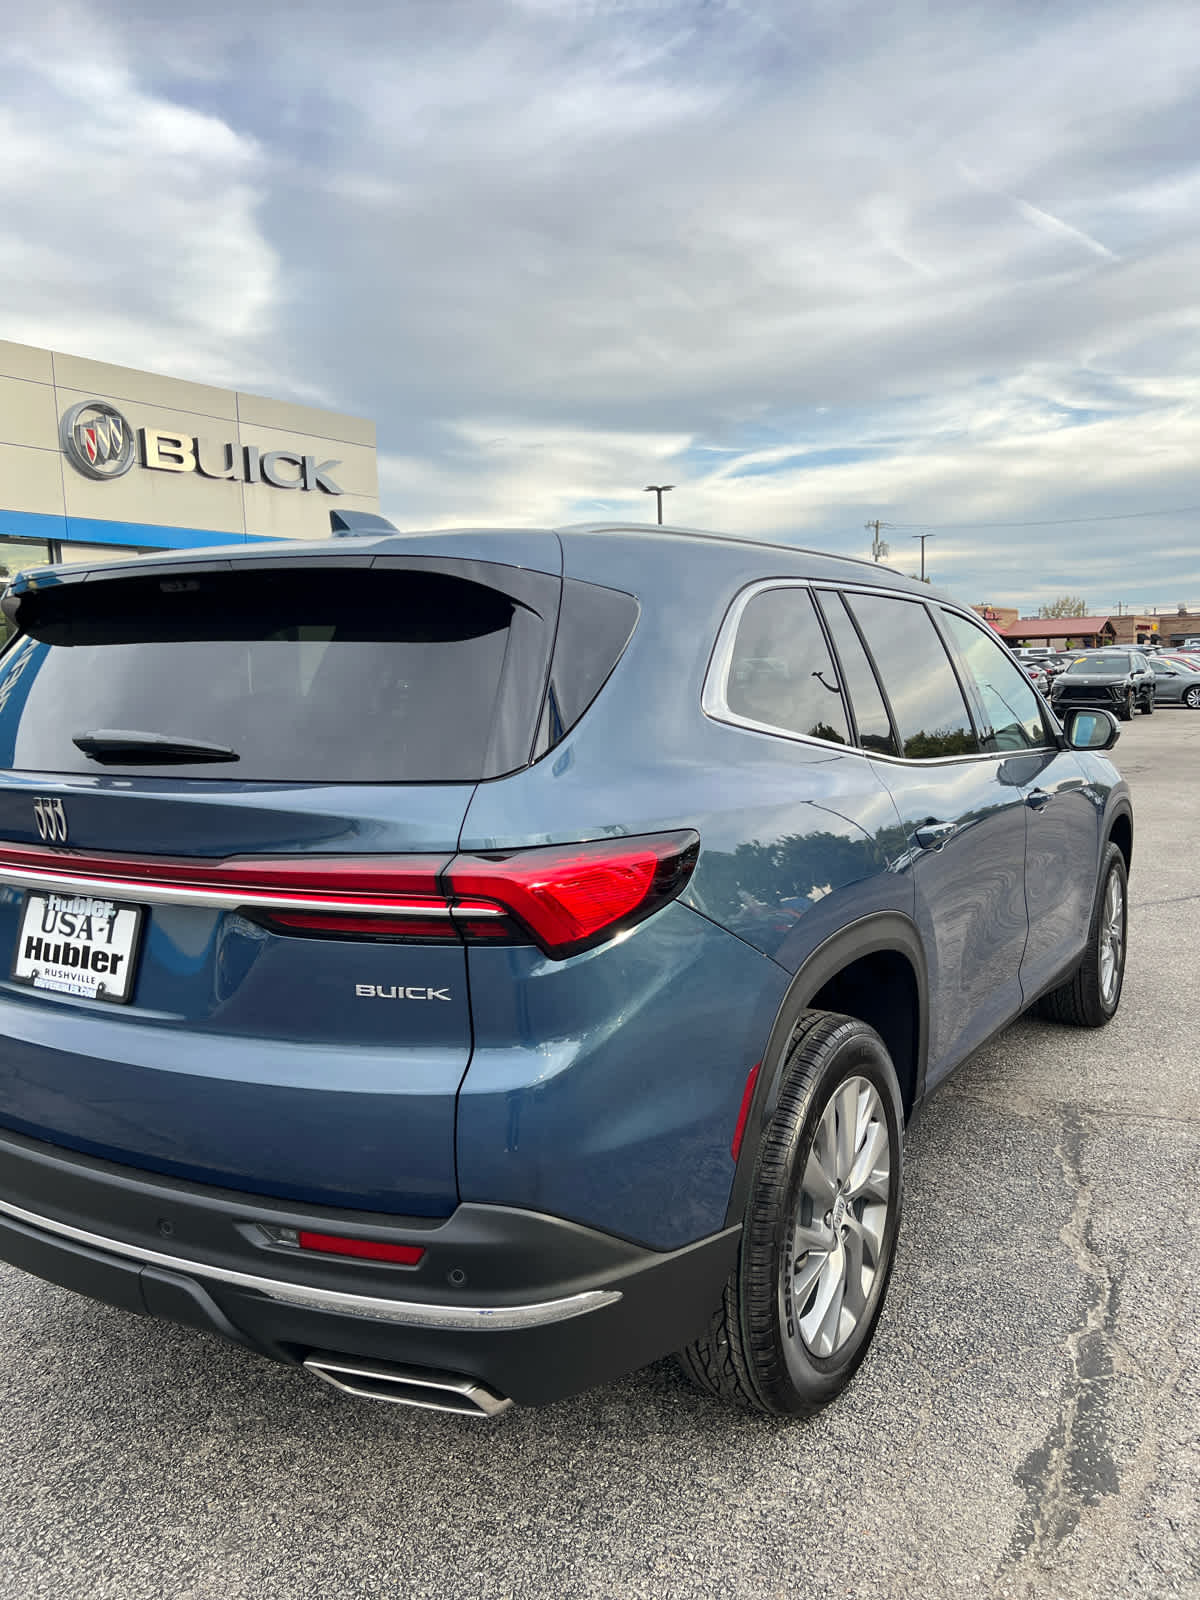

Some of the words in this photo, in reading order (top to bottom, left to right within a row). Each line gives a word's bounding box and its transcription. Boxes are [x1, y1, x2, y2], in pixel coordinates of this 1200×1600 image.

[138, 426, 344, 495] BUICK
[24, 935, 124, 975] Hubler
[44, 967, 97, 985] RUSHVILLE
[355, 983, 452, 1001] BUICK
